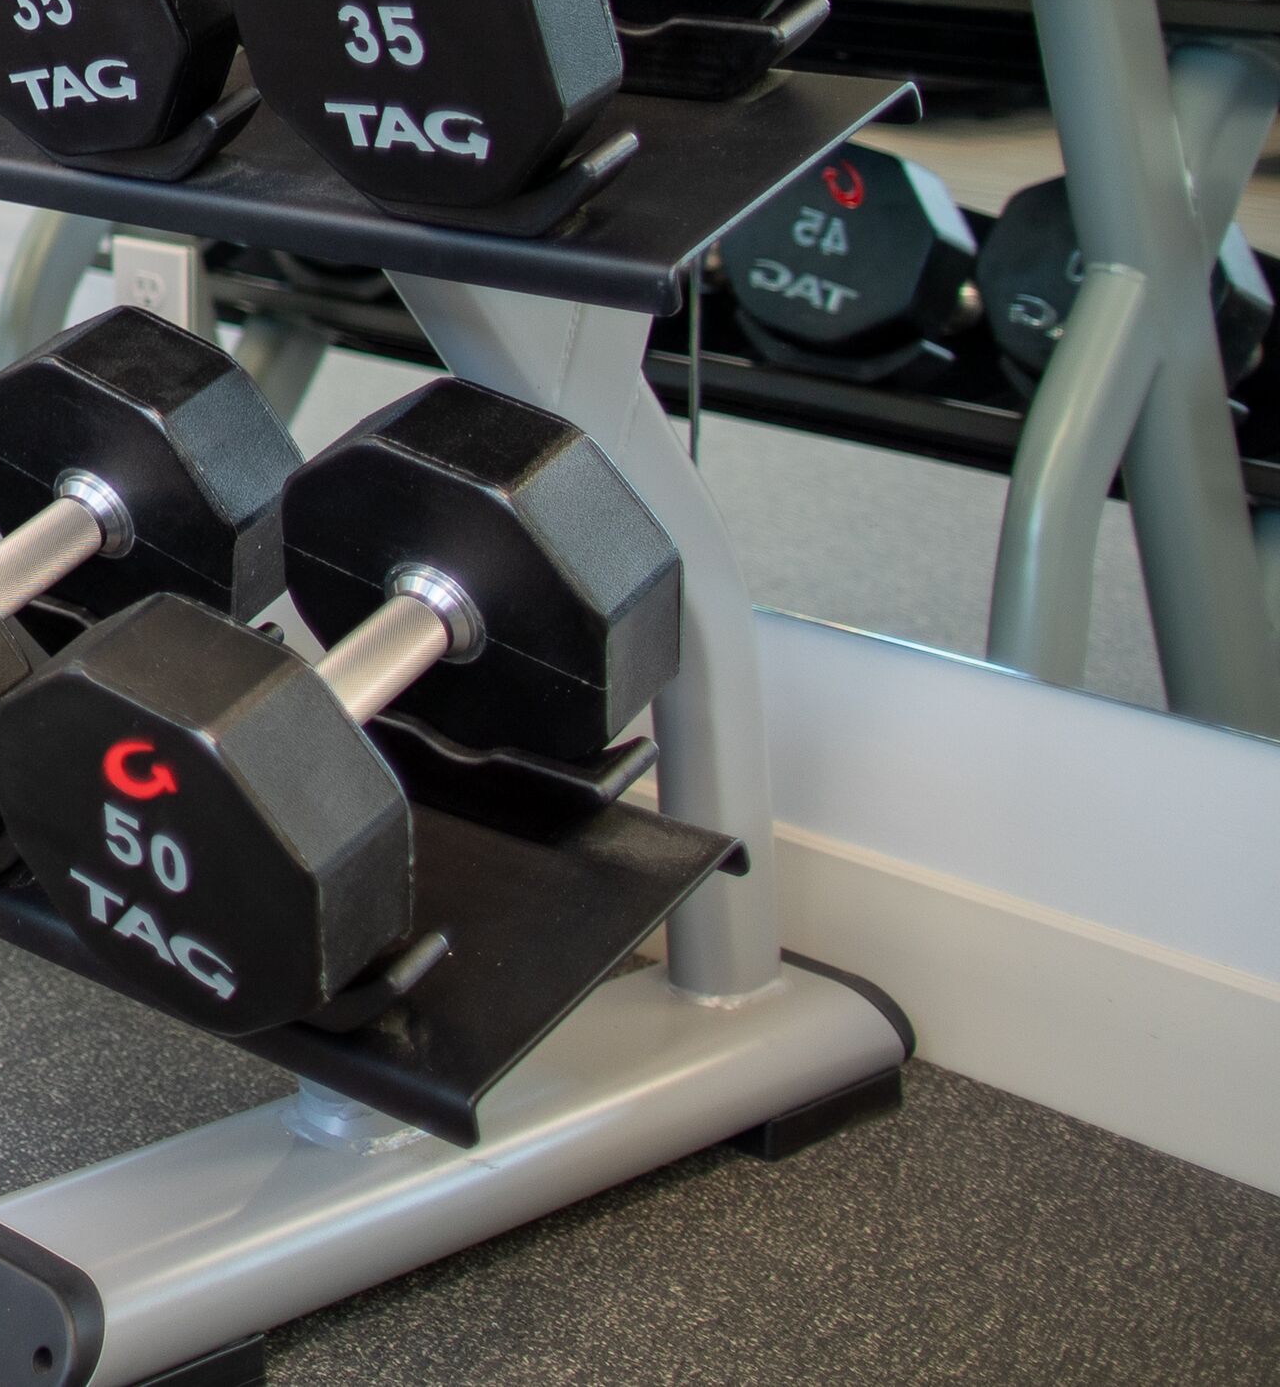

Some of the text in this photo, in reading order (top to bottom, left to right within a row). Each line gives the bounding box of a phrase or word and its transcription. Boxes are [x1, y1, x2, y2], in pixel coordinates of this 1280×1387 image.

[338, 5, 424, 66] 35
[9, 59, 137, 110] TAG
[324, 102, 489, 159] TAG
[102, 803, 187, 894] 50
[69, 868, 235, 1001] TAG
